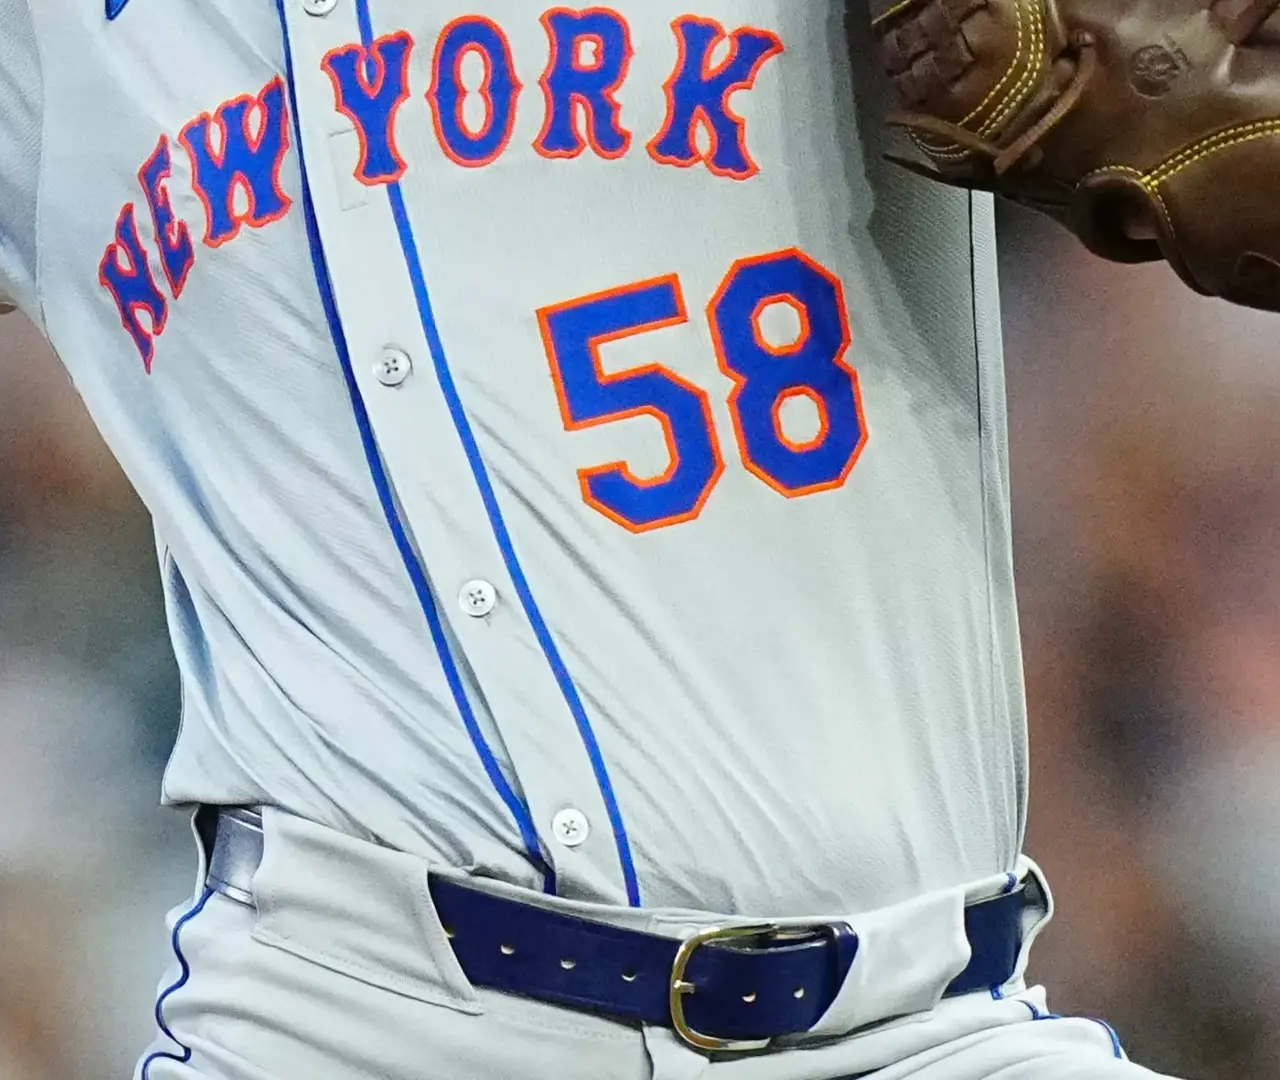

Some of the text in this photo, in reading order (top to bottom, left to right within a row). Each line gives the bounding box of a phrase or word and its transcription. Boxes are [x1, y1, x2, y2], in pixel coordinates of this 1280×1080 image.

[99, 7, 784, 375] NEW YORK
[537, 247, 869, 533] 58
